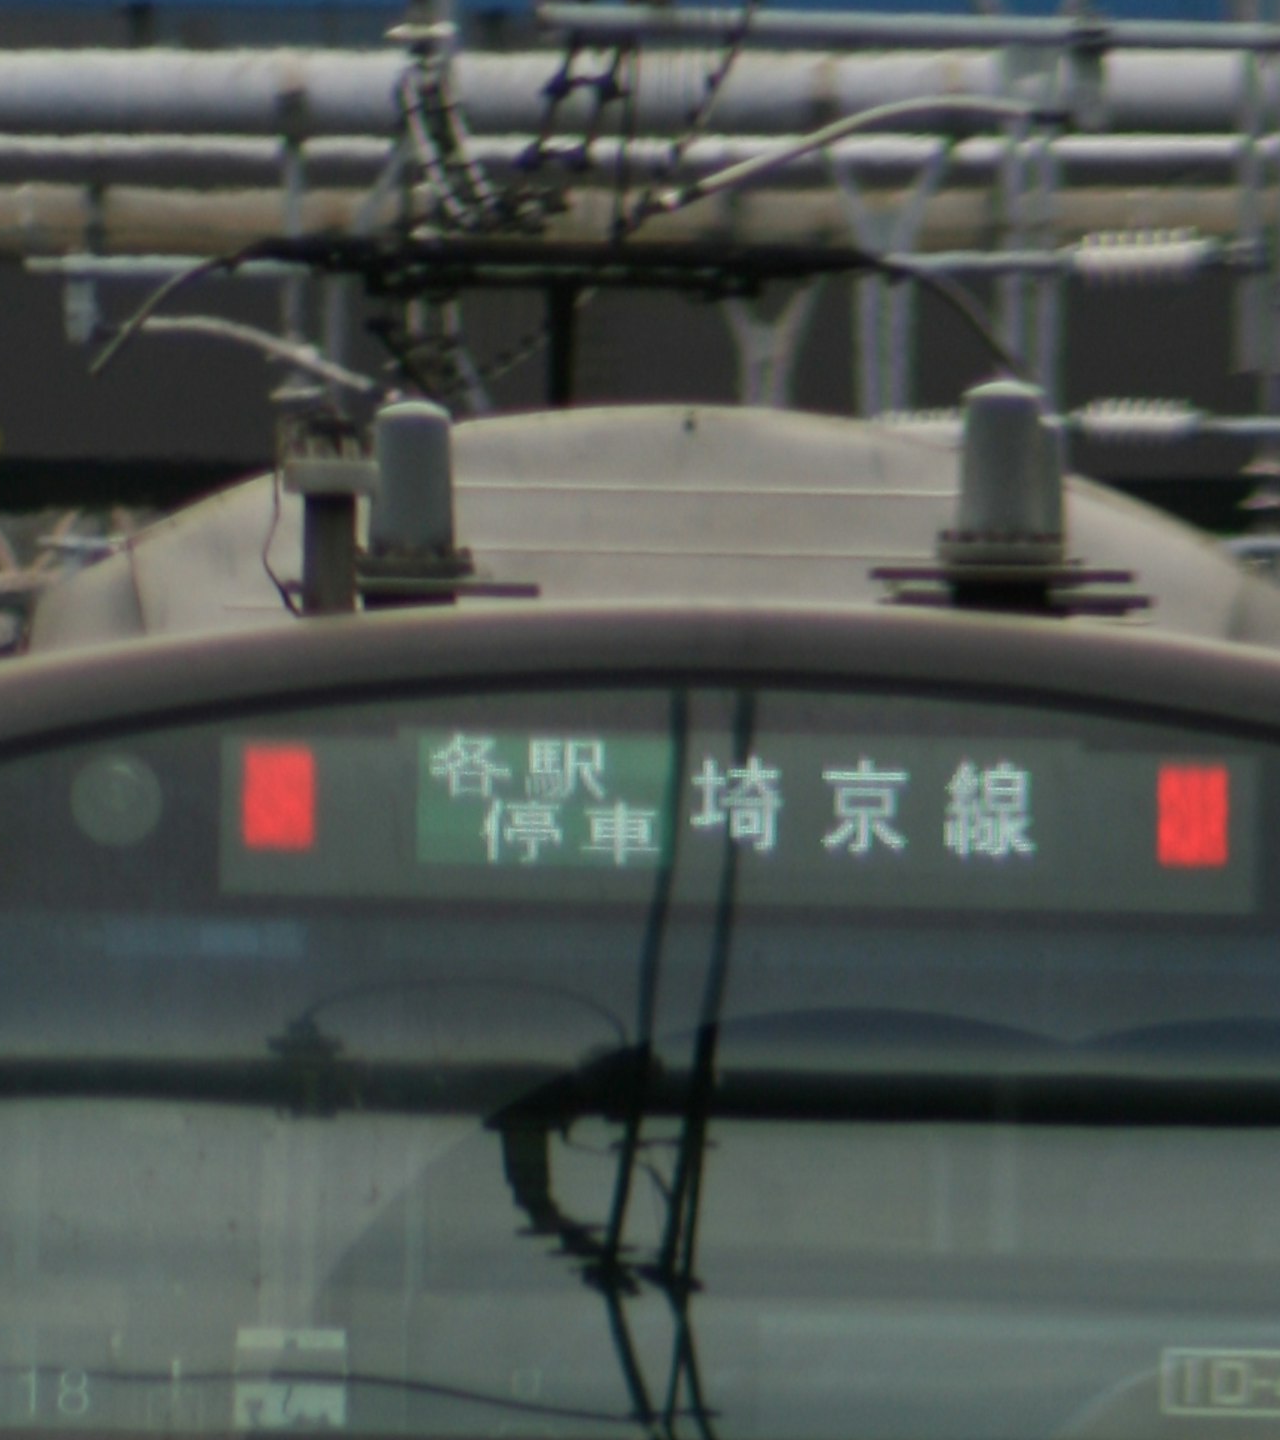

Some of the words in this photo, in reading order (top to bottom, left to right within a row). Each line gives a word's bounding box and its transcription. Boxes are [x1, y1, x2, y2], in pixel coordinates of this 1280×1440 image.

[429, 733, 605, 800] 各駅
[481, 800, 662, 864] 停車
[690, 756, 1038, 857] 埼京線
